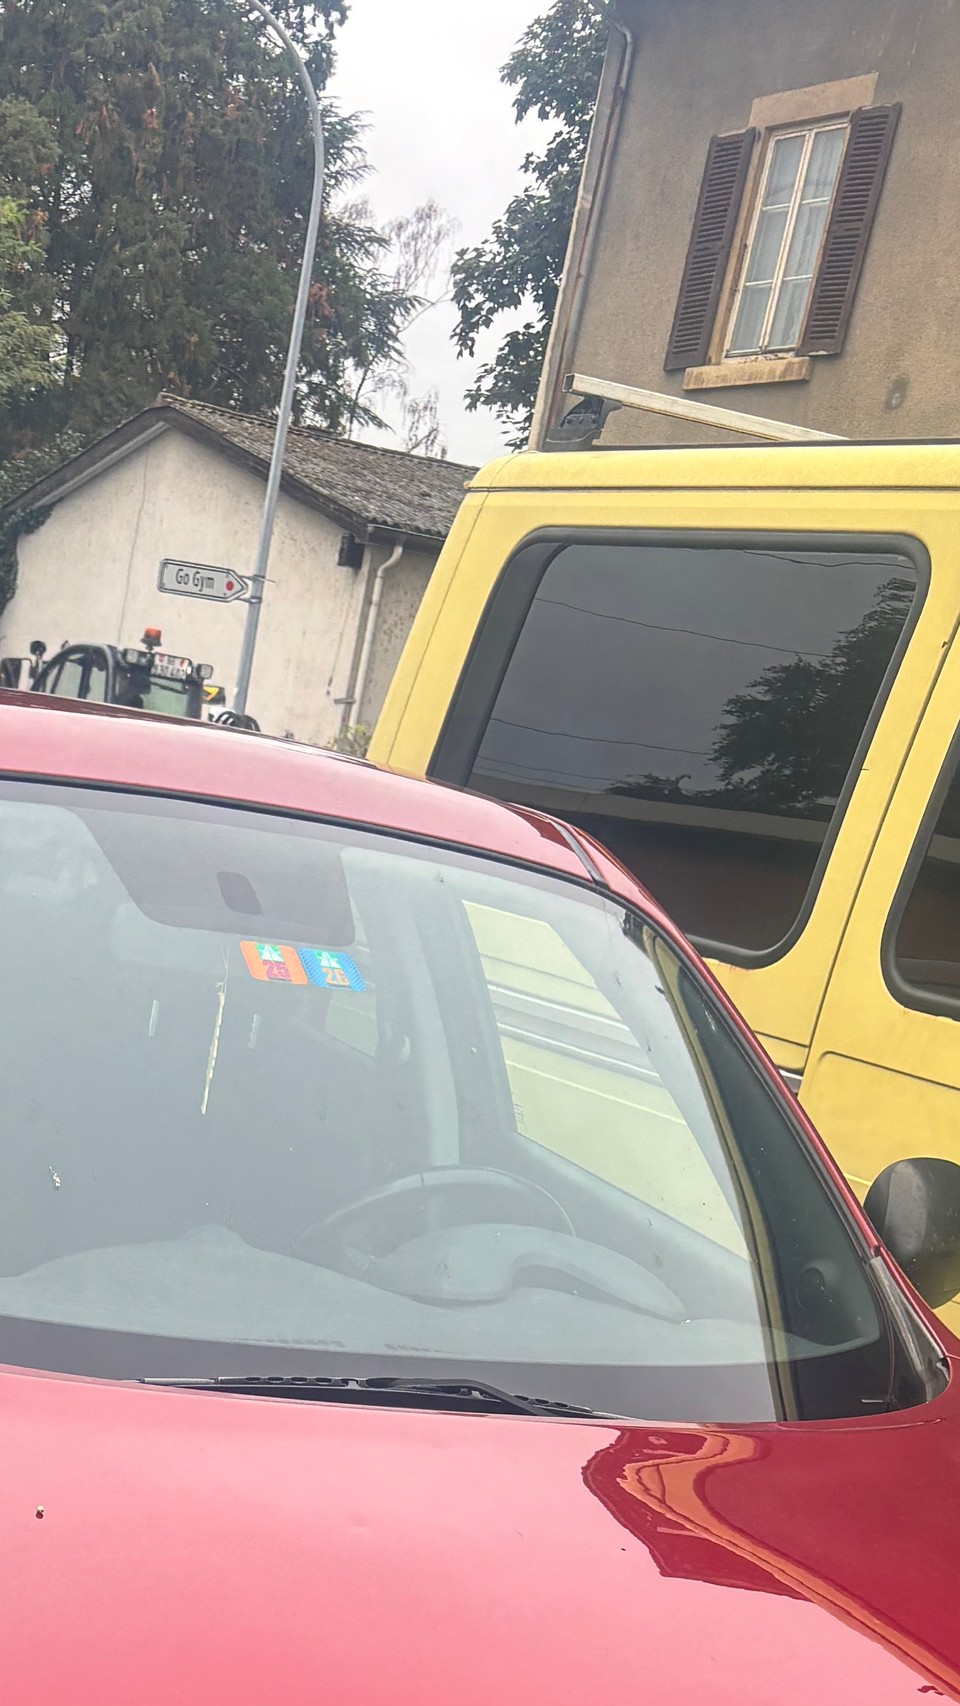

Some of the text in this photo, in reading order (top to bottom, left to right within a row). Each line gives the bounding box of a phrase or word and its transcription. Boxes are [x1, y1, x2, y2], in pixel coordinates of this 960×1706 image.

[175, 568, 215, 592] Go Gym
[262, 960, 292, 980] 25
